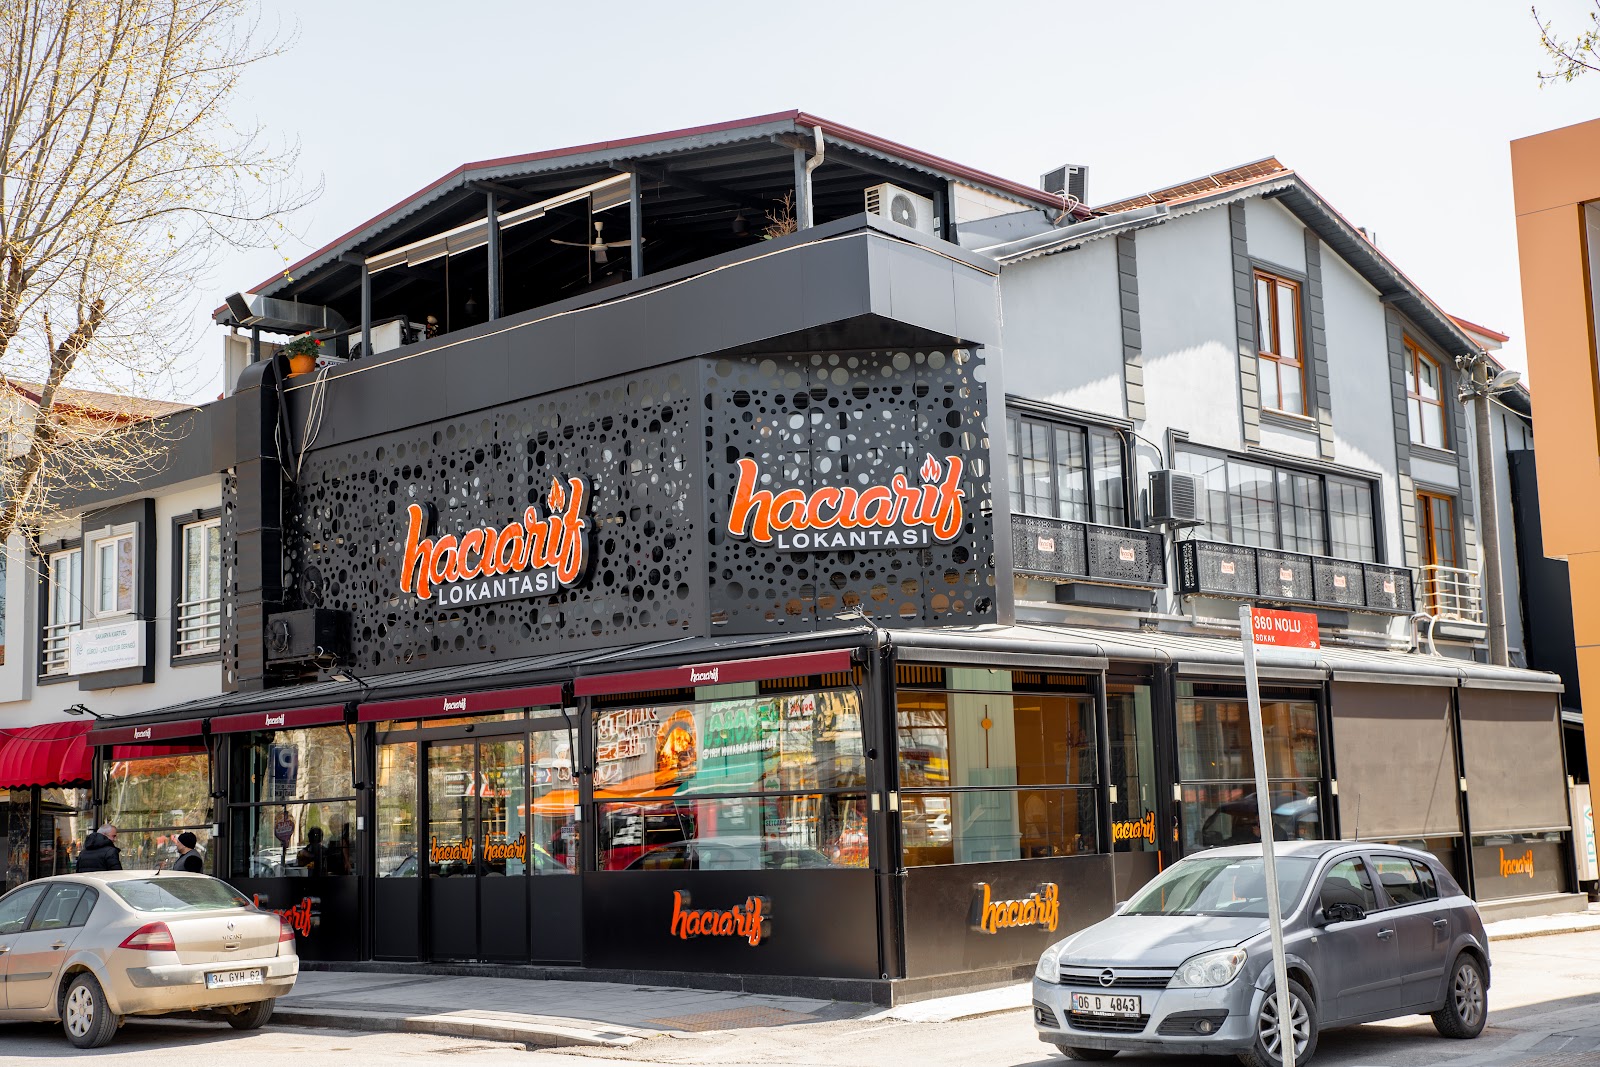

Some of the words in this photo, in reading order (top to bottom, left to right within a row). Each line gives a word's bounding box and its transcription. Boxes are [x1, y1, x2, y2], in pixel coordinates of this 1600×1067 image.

[778, 529, 928, 549] LOKANTASI
[438, 571, 556, 605] LOKANTASI
[1254, 615, 1273, 630] 360
[1274, 617, 1301, 633] NOLU
[1255, 633, 1276, 642] SOKAK
[212, 974, 224, 984] 34
[1078, 996, 1089, 1009] 06
[1095, 997, 1101, 1009] D
[1110, 998, 1135, 1011] 4843
